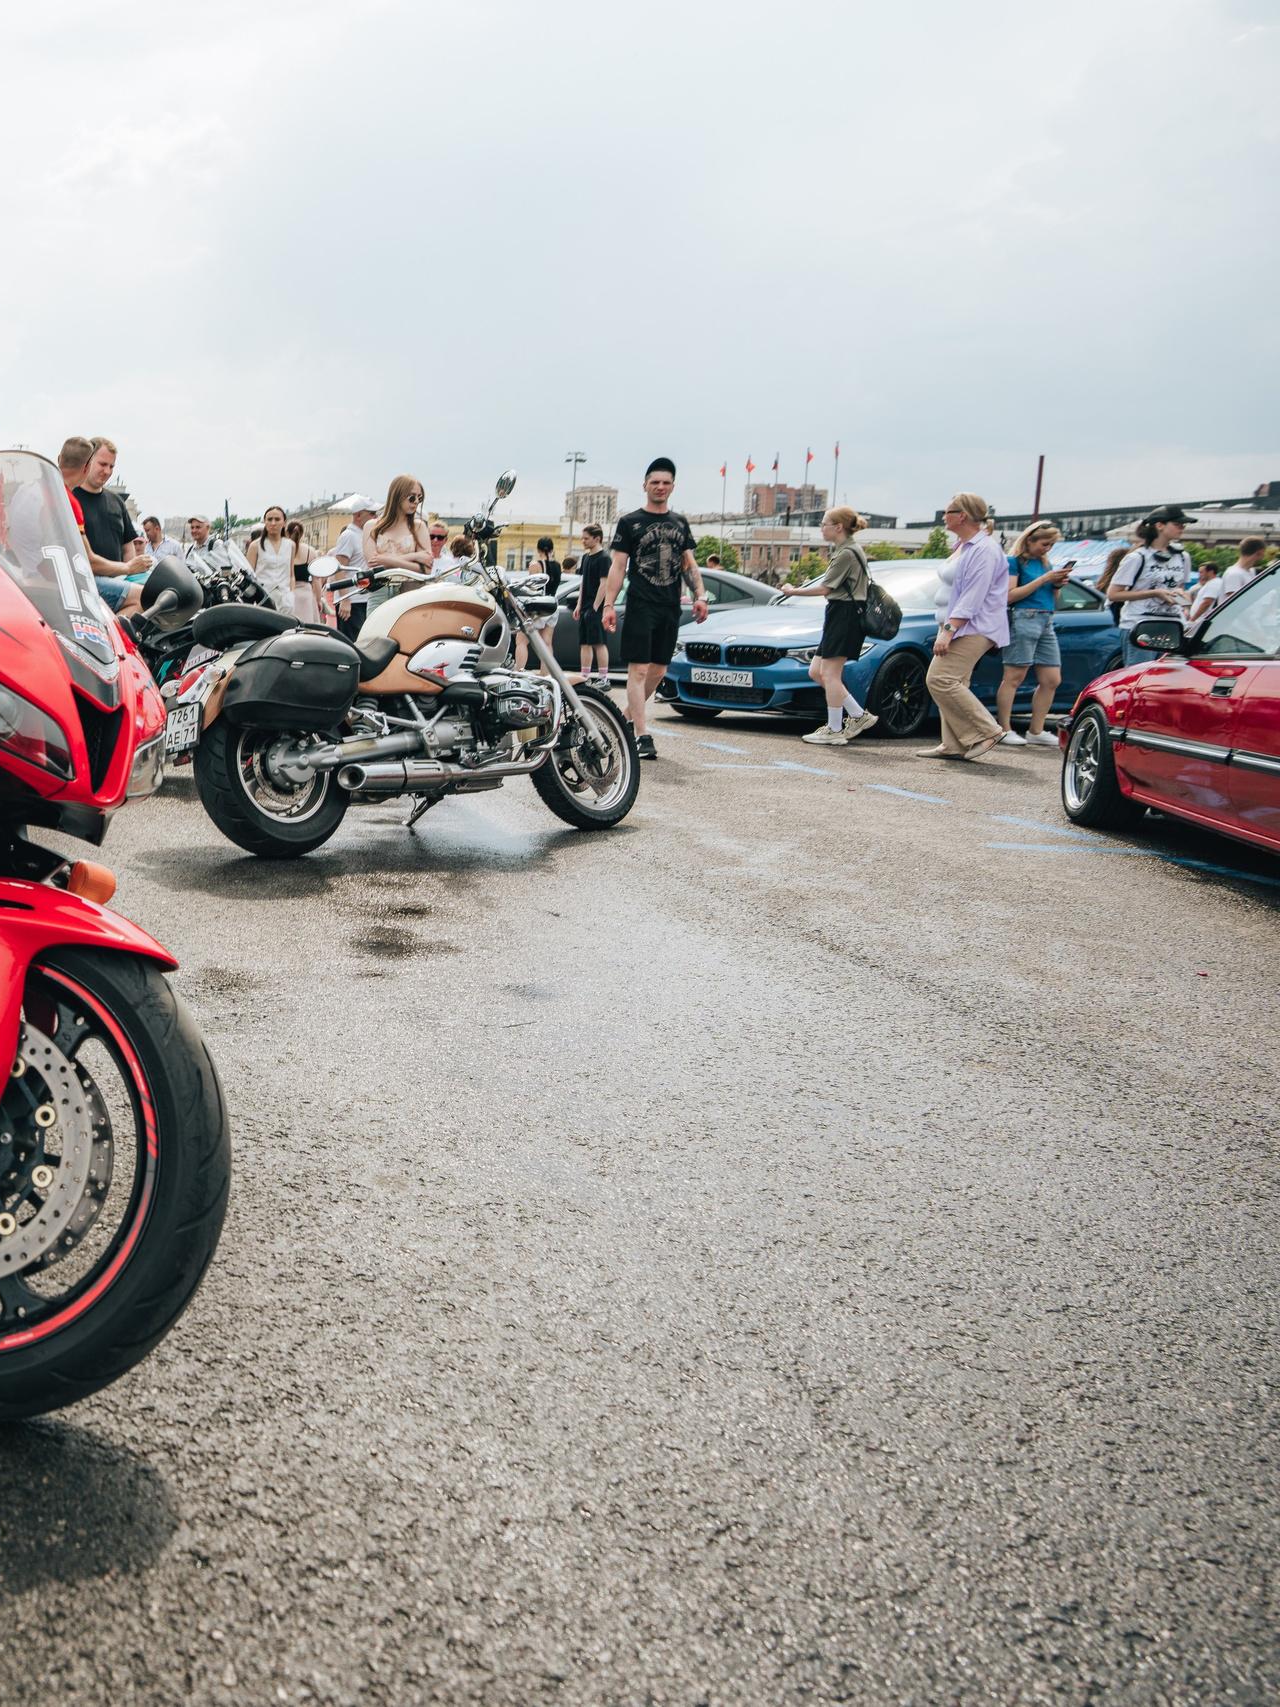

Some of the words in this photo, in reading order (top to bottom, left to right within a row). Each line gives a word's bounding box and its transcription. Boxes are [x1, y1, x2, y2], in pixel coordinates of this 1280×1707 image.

[732, 672, 749, 683] 797
[171, 706, 195, 726] 7261
[167, 731, 181, 748] AE
[184, 726, 195, 742] 71
